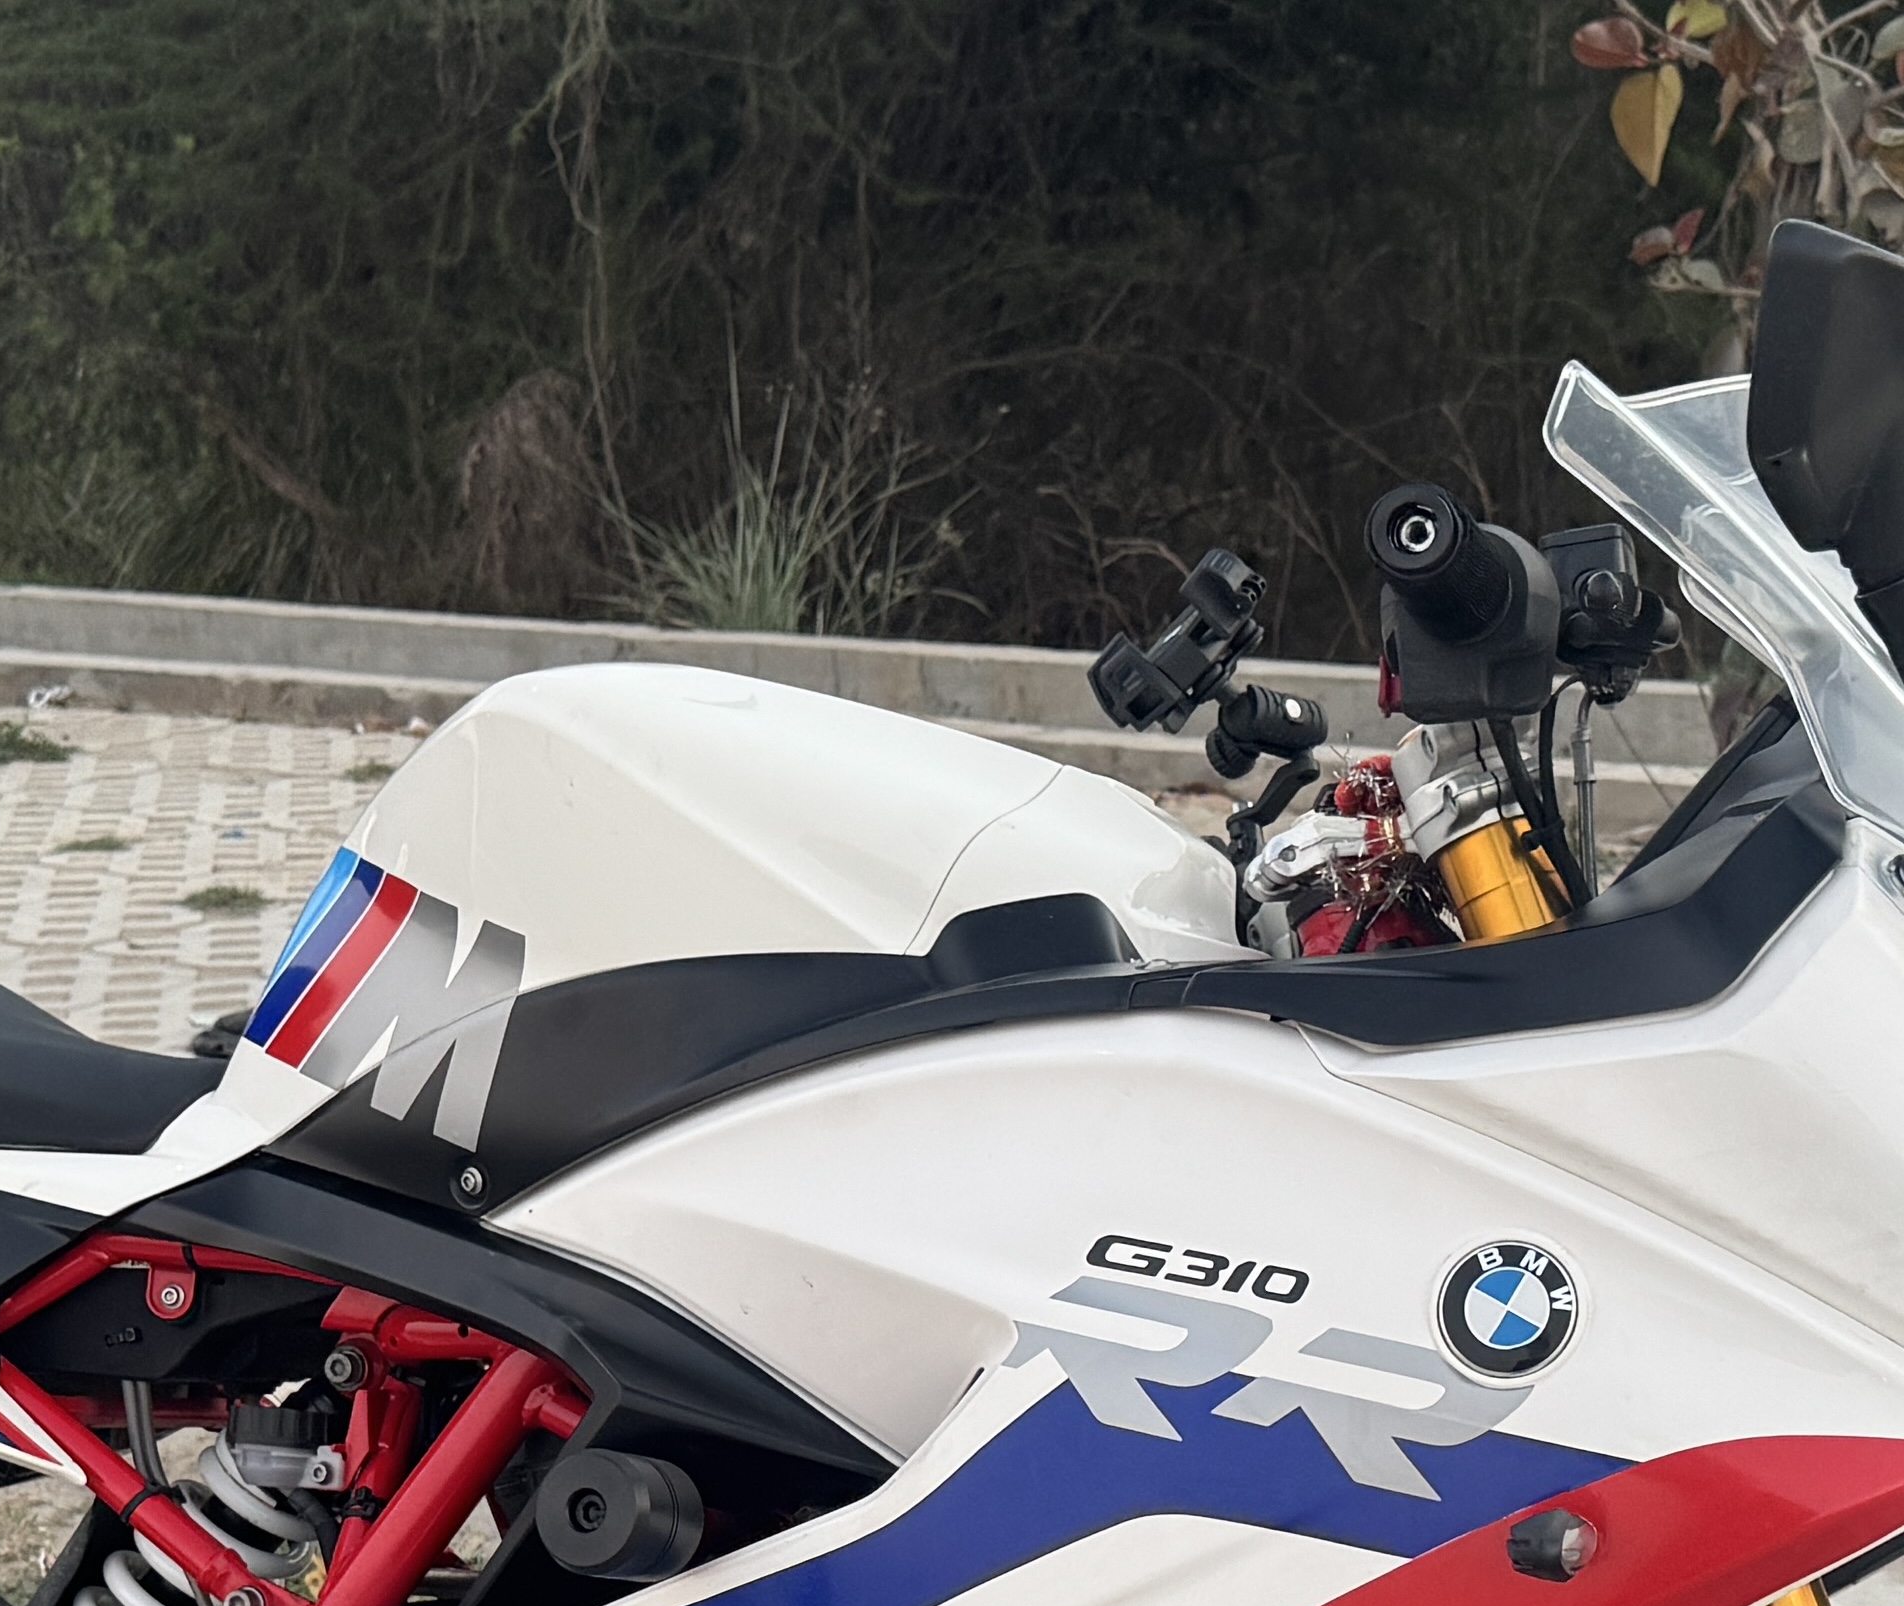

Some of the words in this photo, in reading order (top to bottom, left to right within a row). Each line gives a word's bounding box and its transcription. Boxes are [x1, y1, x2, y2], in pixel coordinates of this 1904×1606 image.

[299, 891, 526, 1153] M
[1086, 1234, 1310, 1304] G310
[1477, 1246, 1574, 1312] BMW
[1001, 1276, 1535, 1501] RR
